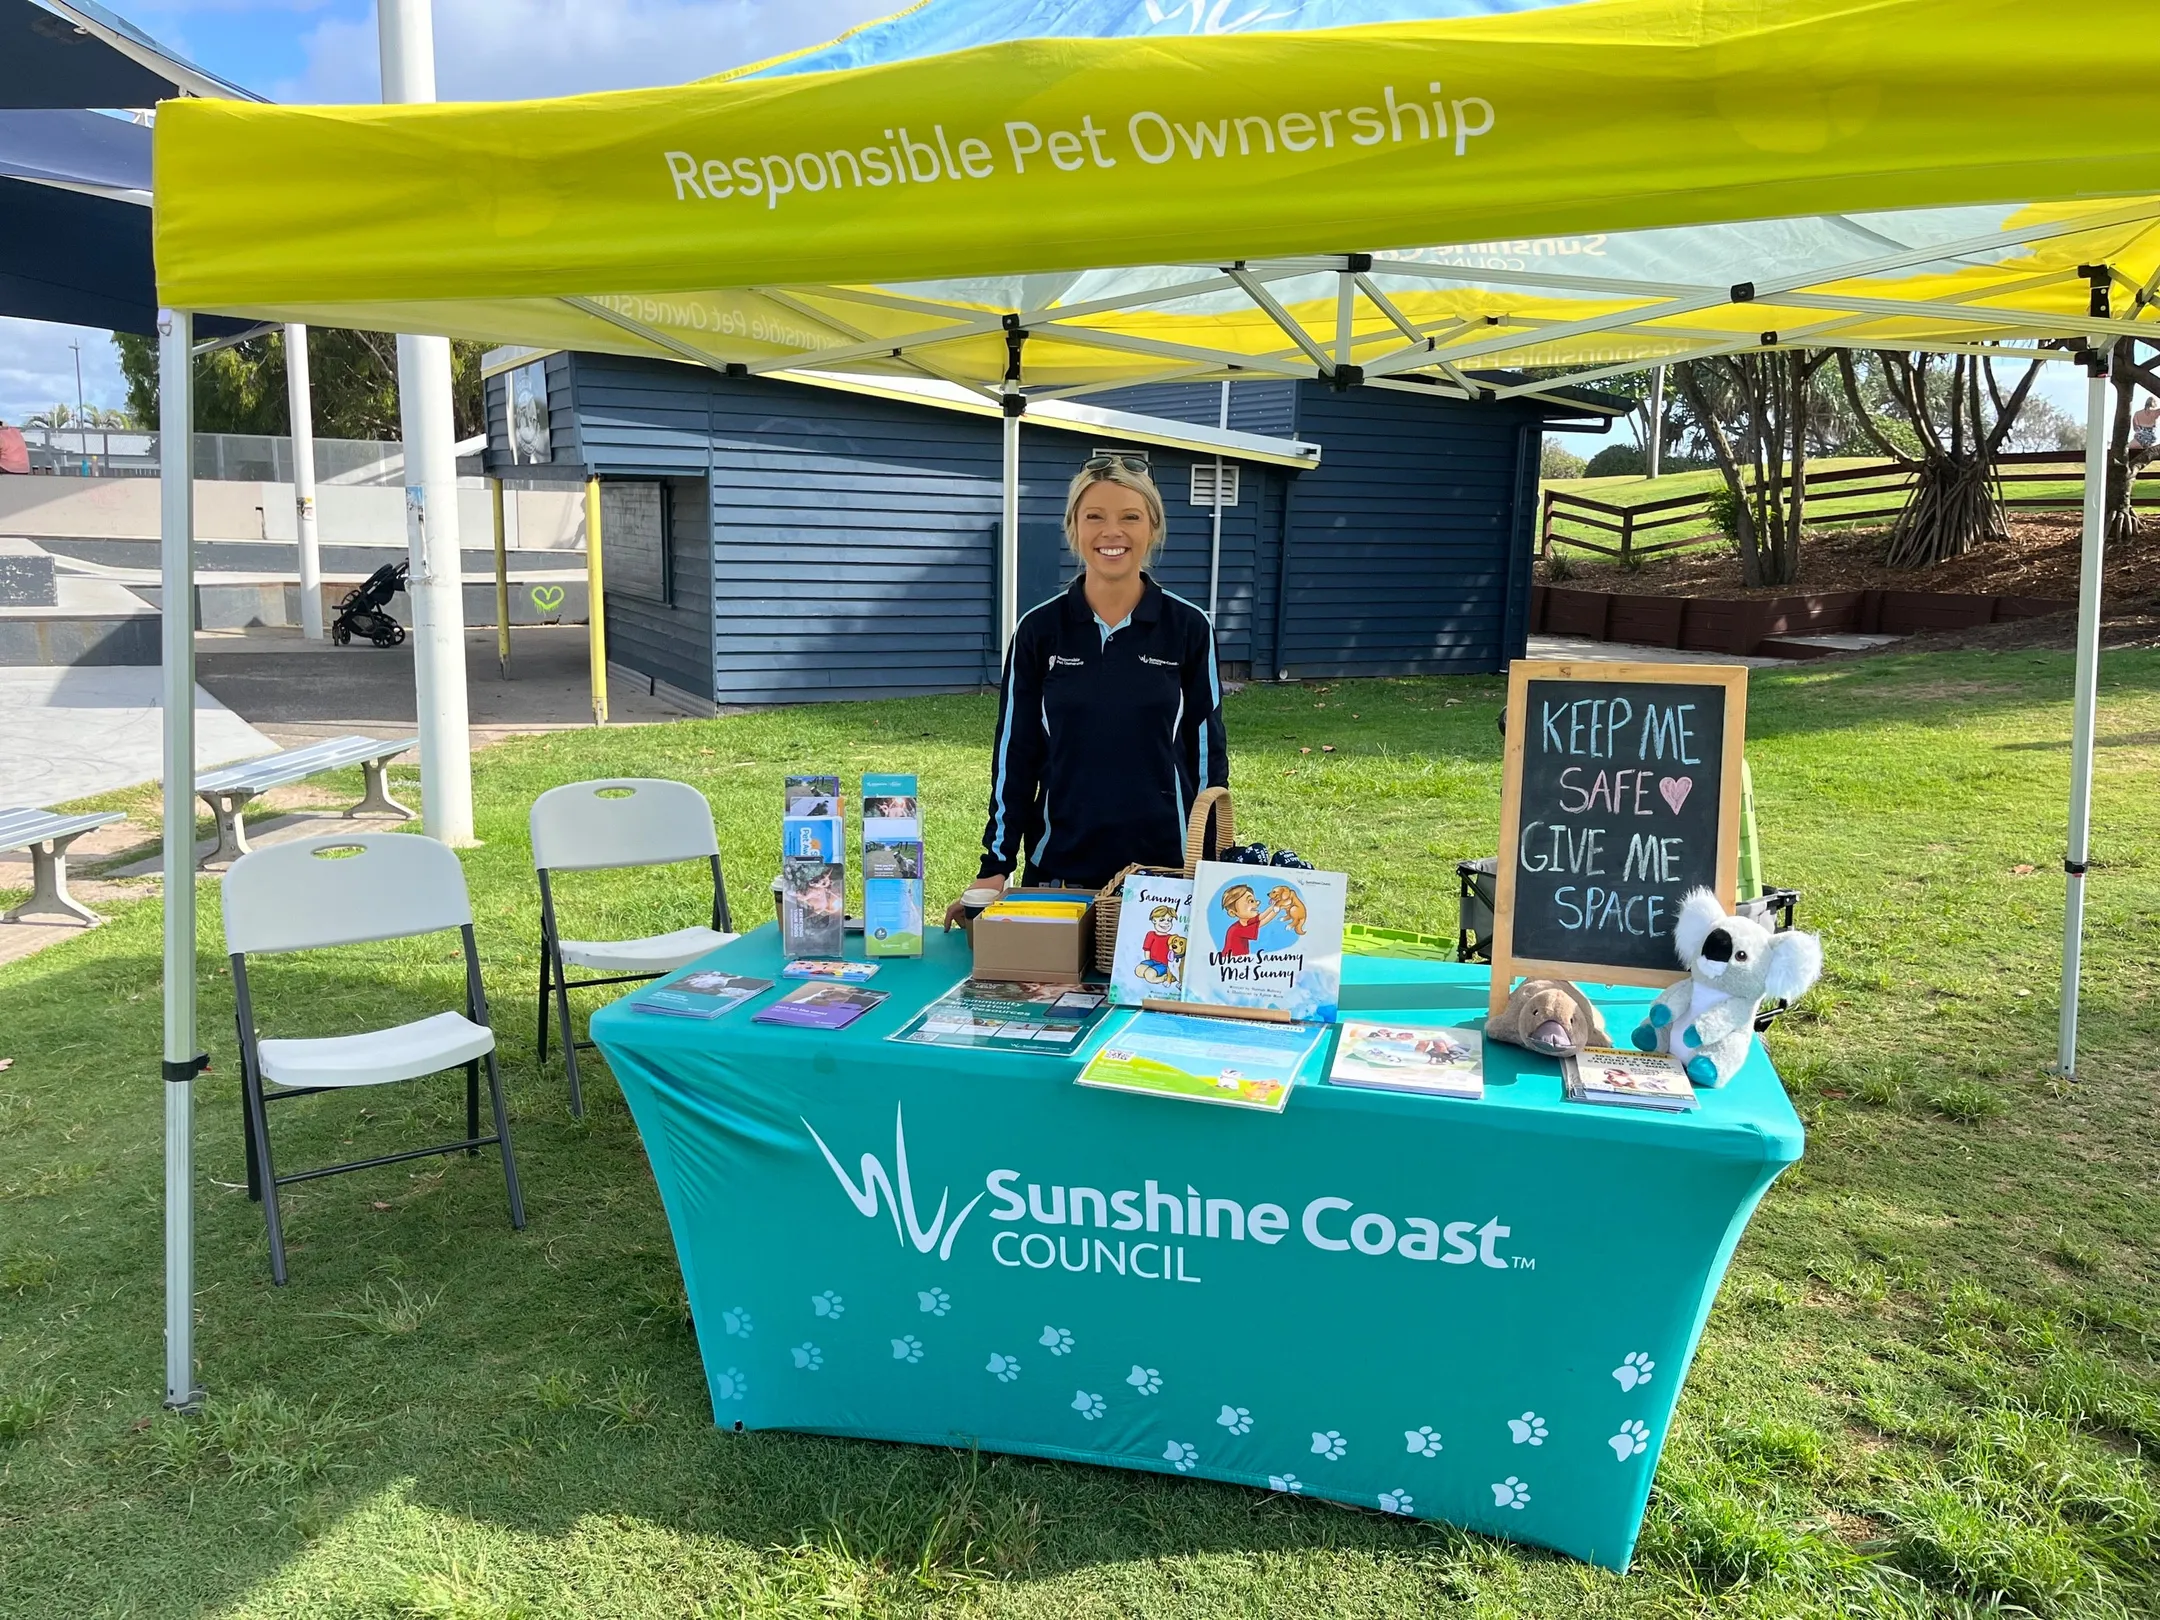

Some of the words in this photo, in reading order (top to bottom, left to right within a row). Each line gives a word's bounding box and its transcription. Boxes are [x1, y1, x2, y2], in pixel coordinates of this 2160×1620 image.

[664, 123, 995, 210] Responsible
[1004, 113, 1117, 175] Pet
[1127, 81, 1497, 156] Ownership
[1543, 697, 1632, 759] KEEP
[1638, 703, 1701, 765] ME
[1559, 767, 1654, 816] SAFE
[1521, 821, 1606, 877] GIVE
[1623, 833, 1684, 883] ME
[1139, 889, 1181, 912] Sammy
[1554, 886, 1668, 938] SPACE
[1209, 951, 1254, 967] When
[1256, 948, 1304, 971] Sammy
[1220, 965, 1250, 982] Met
[1253, 965, 1296, 988] Sunny
[985, 1169, 1290, 1245] Sunshine
[1301, 1196, 1510, 1268] Coast
[991, 1232, 1202, 1284] COUNCIL
